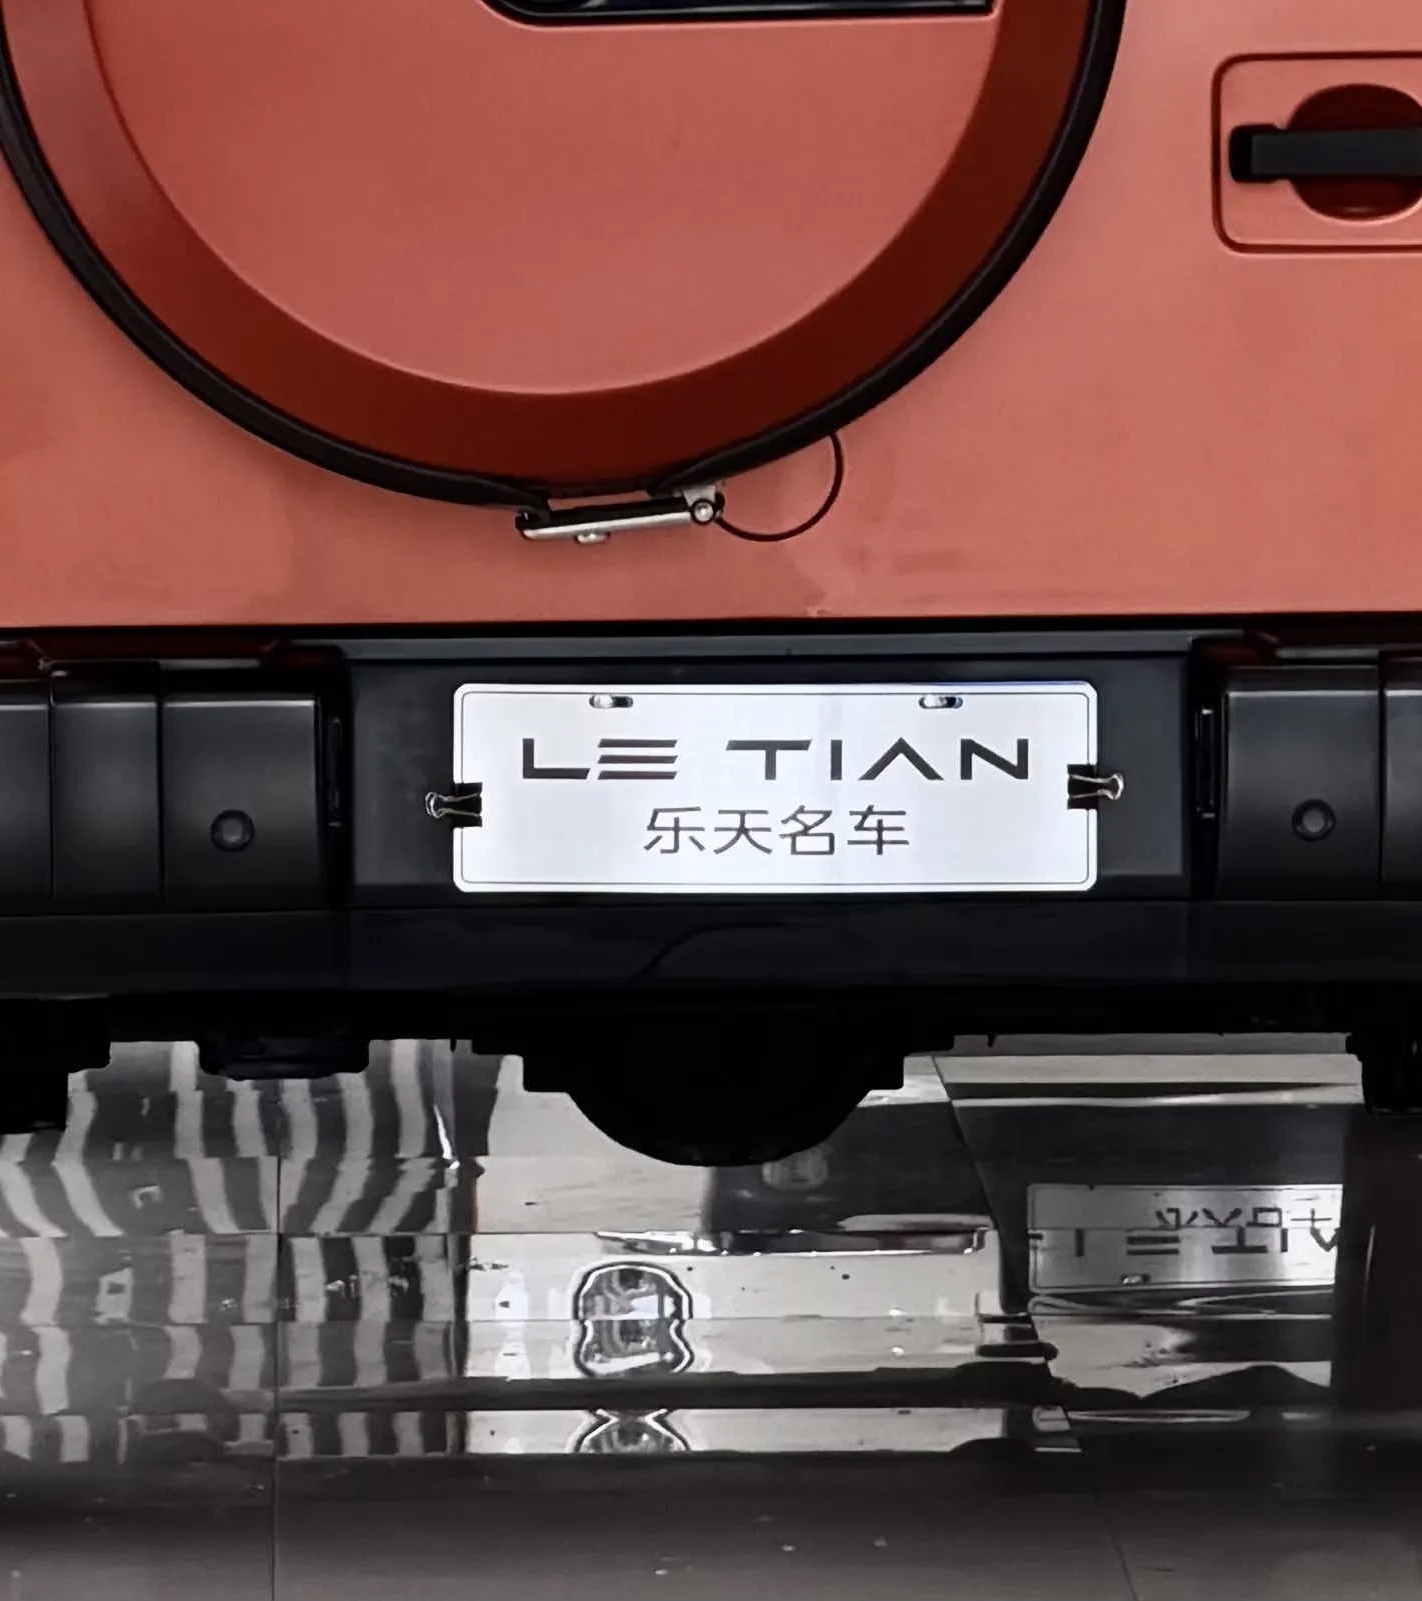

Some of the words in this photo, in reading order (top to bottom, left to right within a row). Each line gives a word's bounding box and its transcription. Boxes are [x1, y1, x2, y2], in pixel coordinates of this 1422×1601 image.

[522, 738, 678, 781] LE
[726, 737, 1029, 781] TIAN
[643, 804, 910, 856] 乐天名车
